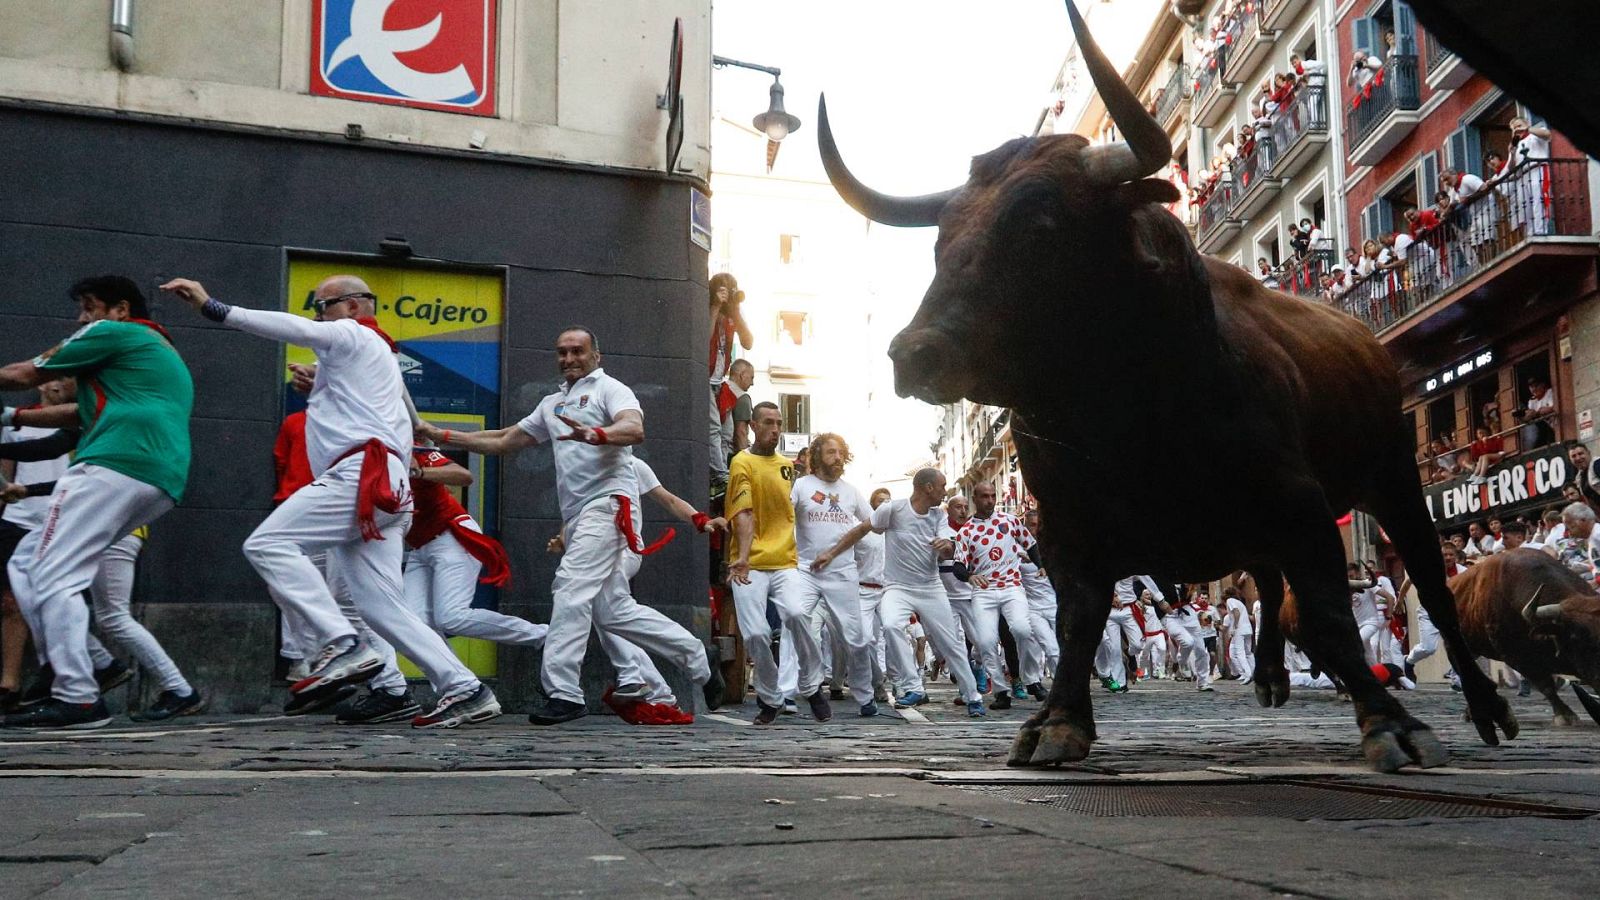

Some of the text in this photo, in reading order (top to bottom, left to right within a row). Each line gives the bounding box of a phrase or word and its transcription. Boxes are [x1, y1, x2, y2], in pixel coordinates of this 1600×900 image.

[394, 295, 488, 325] Cajero
[808, 511, 849, 520] NAFARROA
[1426, 494, 1437, 523] L
